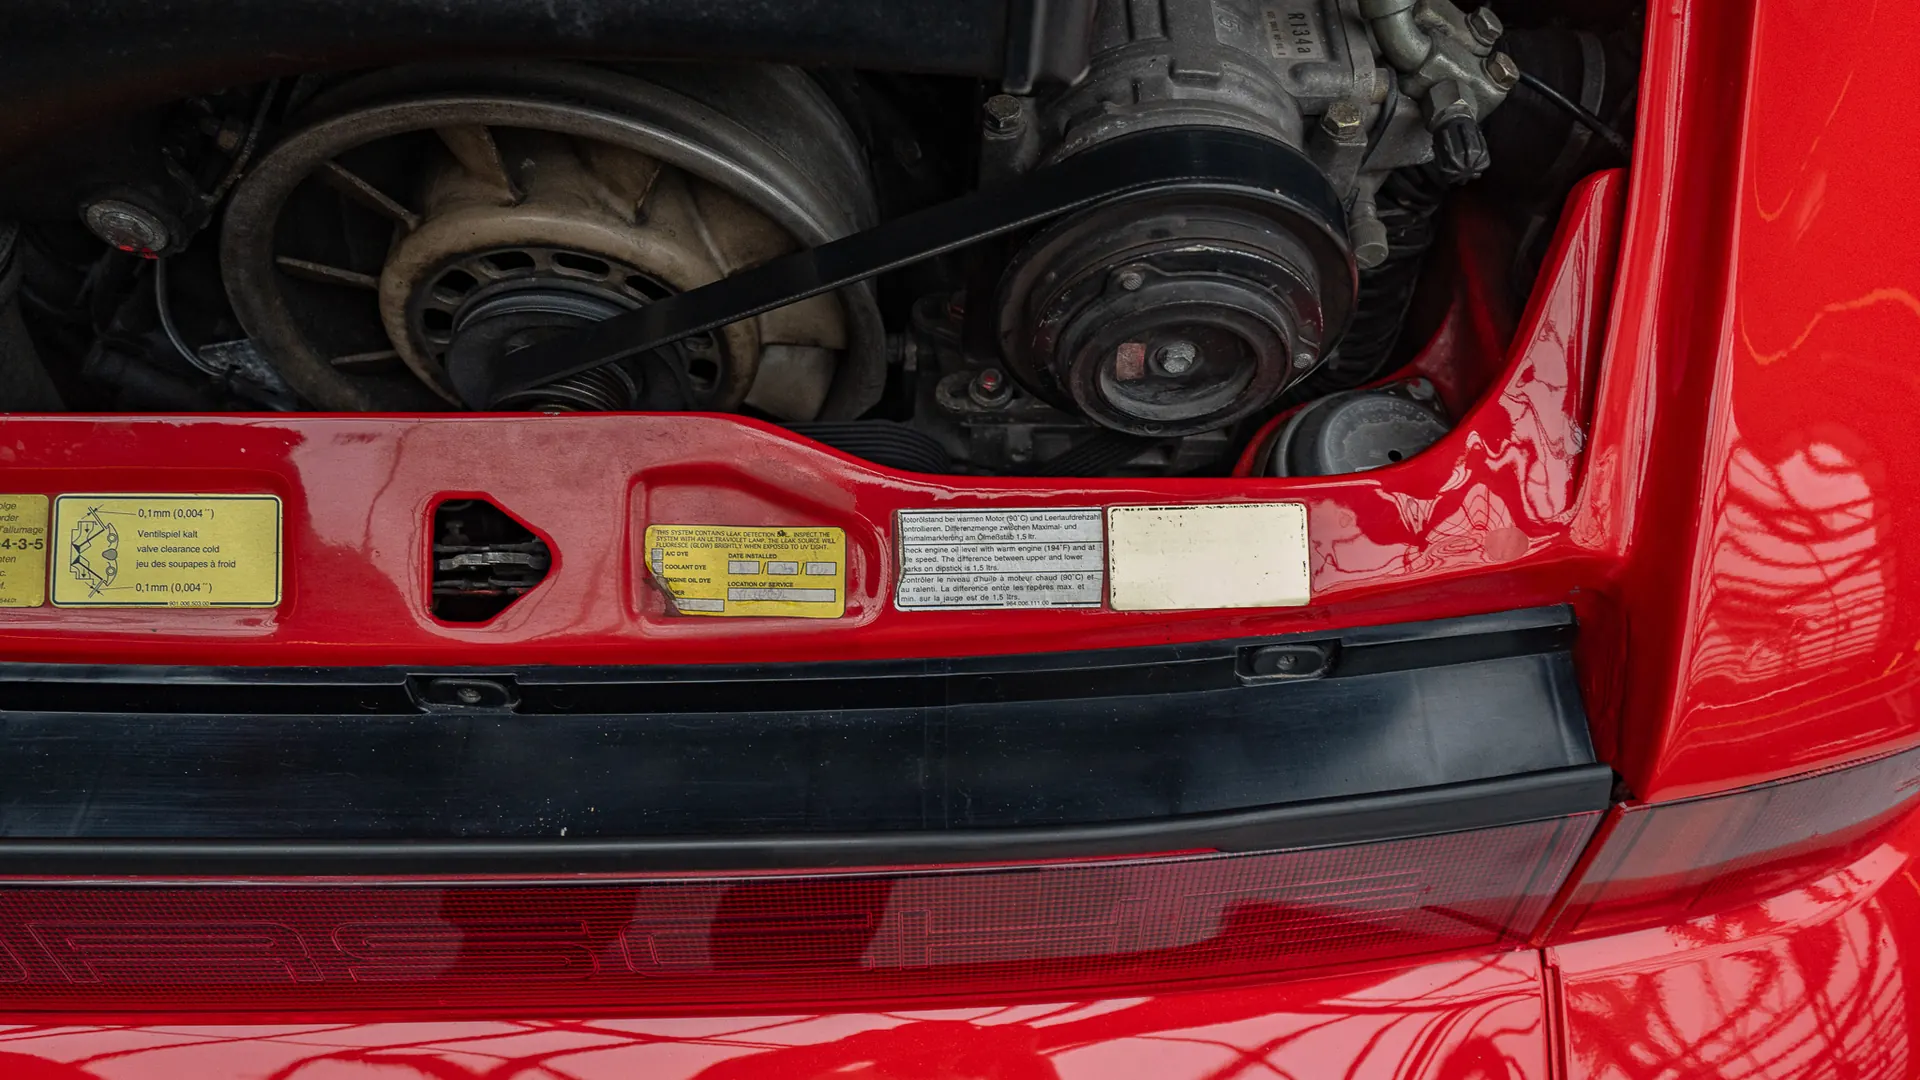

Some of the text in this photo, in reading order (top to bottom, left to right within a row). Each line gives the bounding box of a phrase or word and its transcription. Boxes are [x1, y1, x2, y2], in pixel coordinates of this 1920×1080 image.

[1288, 12, 1314, 54] R134a
[138, 530, 198, 540] Ventilspiel kalt
[0, 538, 44, 550] 4-3-5
[202, 545, 220, 553] cold
[136, 560, 149, 569] jeu
[210, 560, 216, 568] à
[218, 560, 236, 568] froid
